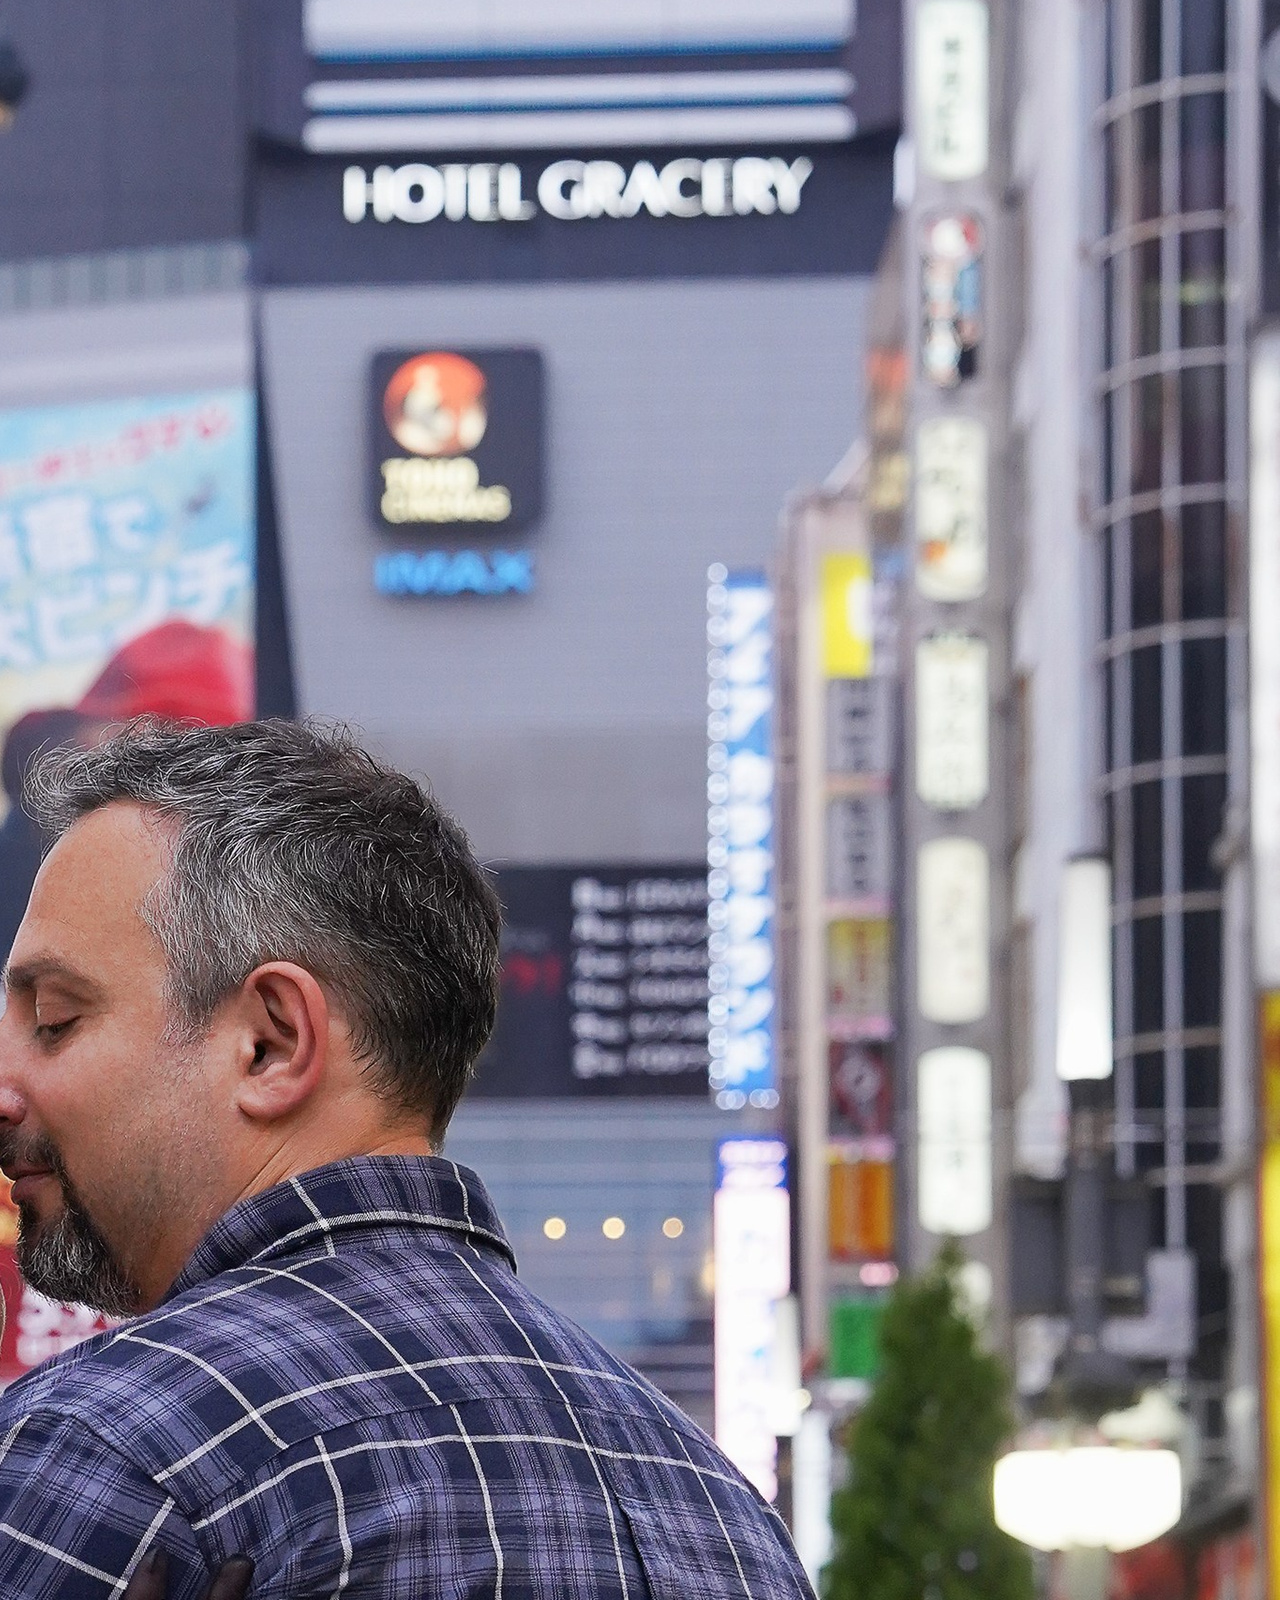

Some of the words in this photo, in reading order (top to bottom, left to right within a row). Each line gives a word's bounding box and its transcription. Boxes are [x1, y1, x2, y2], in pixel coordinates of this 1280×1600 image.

[342, 163, 537, 223] HOTEL
[537, 156, 814, 220] GRACERY
[374, 551, 533, 594] IMAX
